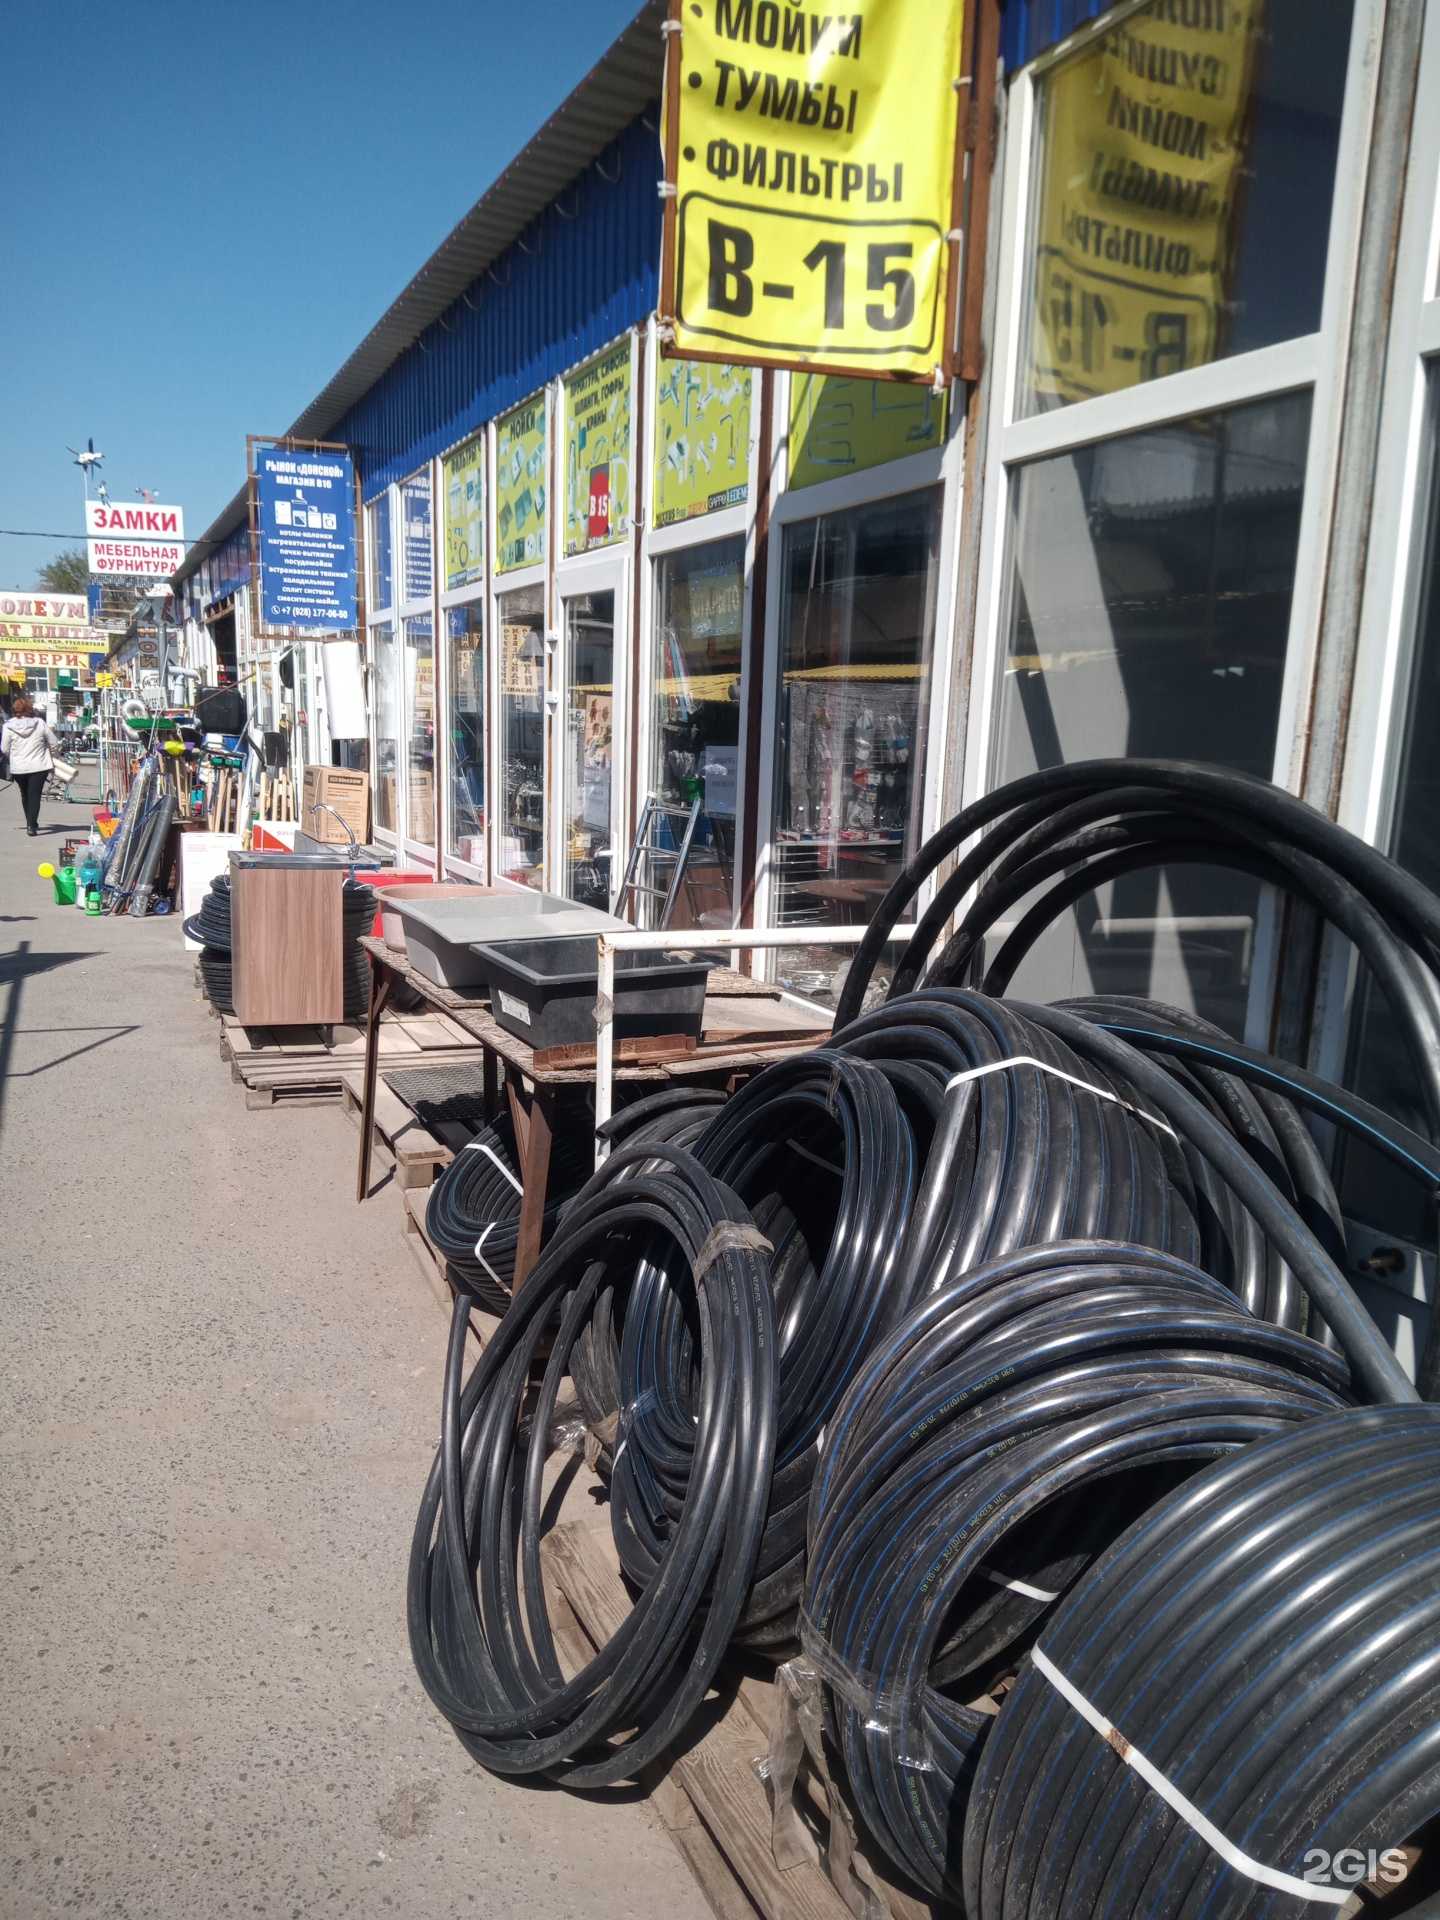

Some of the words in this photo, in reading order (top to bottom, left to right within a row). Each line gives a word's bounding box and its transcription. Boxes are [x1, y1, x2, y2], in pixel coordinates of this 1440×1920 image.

[714, 59, 857, 134] ТУМБЫ
[706, 138, 904, 203] ФИЛЬТРЫ
[707, 218, 916, 333] В-15
[265, 460, 296, 473] РЫНОК
[276, 475, 315, 487] МАГАЗИН
[94, 508, 177, 532] ЗАМКИ
[94, 543, 179, 560] МЕБЕЛЬНАЯ
[97, 558, 177, 574] ФУРНИТУРА
[11, 652, 79, 667] ДВЕРИ
